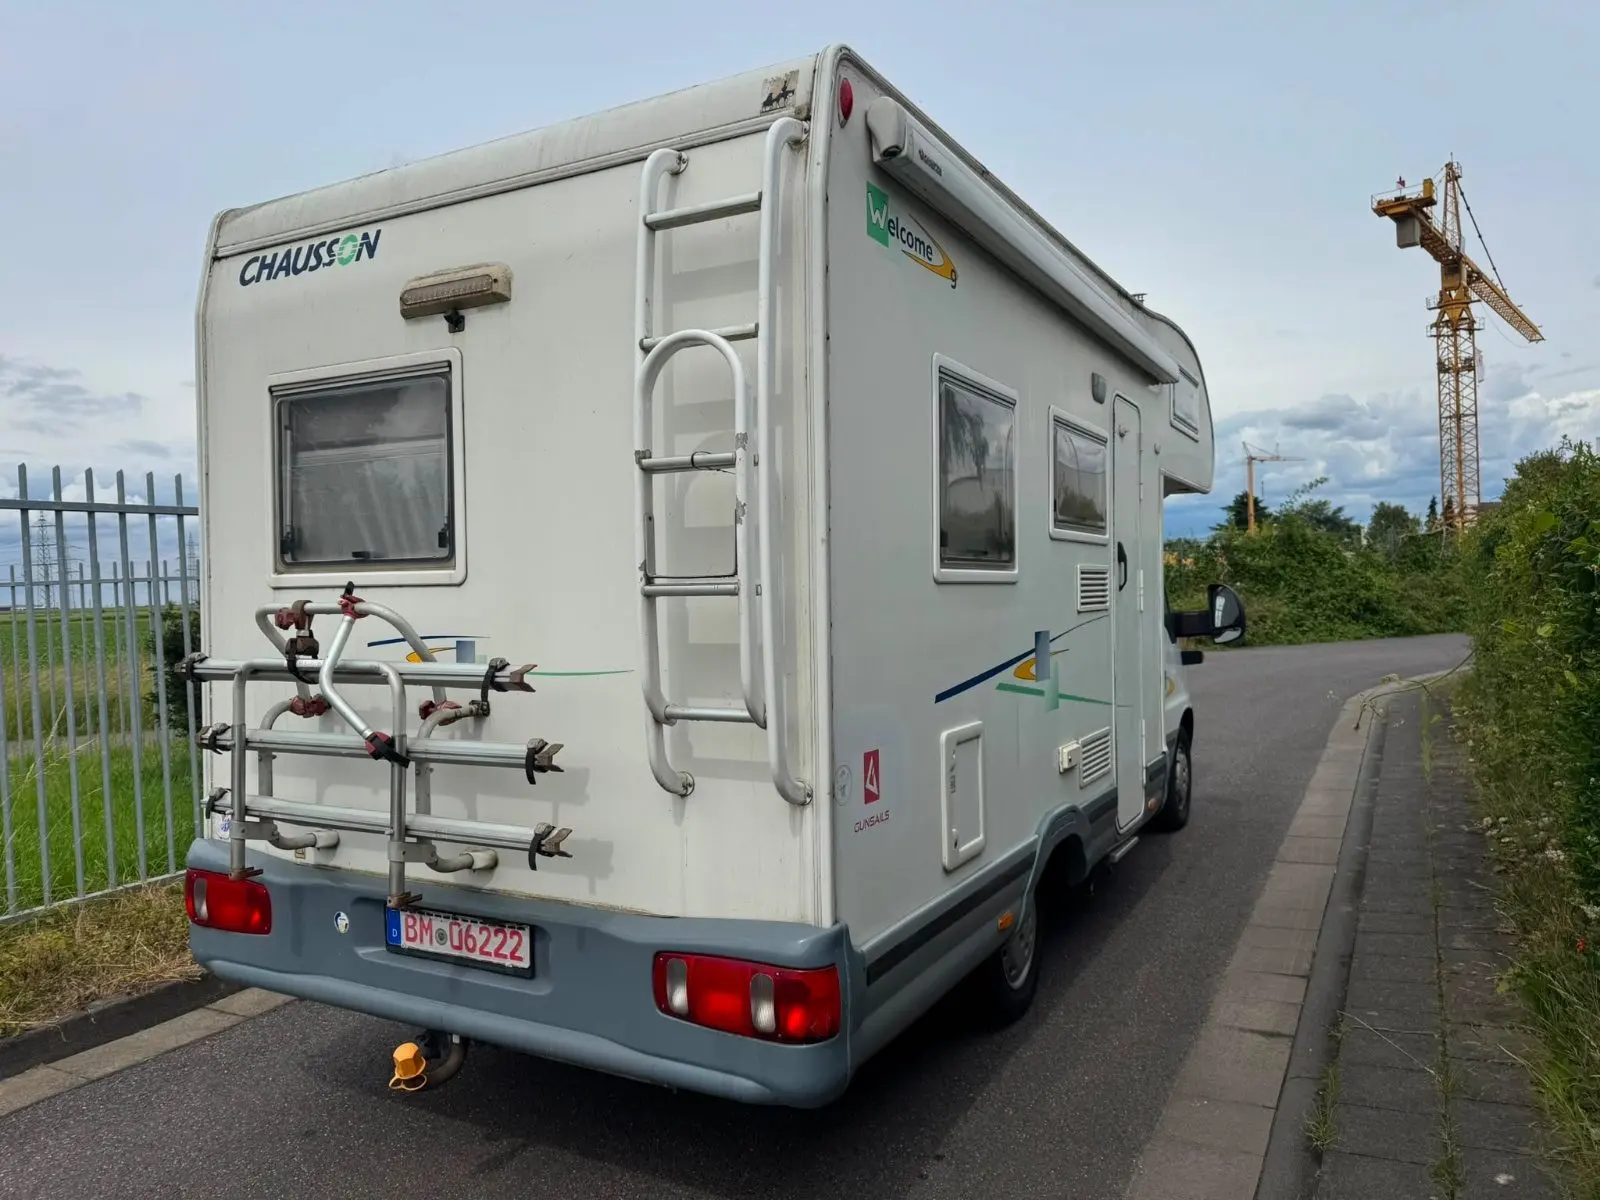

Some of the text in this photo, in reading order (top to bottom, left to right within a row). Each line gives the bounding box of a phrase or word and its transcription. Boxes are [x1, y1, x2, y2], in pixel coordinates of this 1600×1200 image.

[868, 192, 933, 262] Welcome
[239, 228, 382, 287] CHAUSSON
[853, 810, 890, 834] GUNSAILS
[391, 927, 398, 938] D
[404, 914, 524, 962] BM 06222
